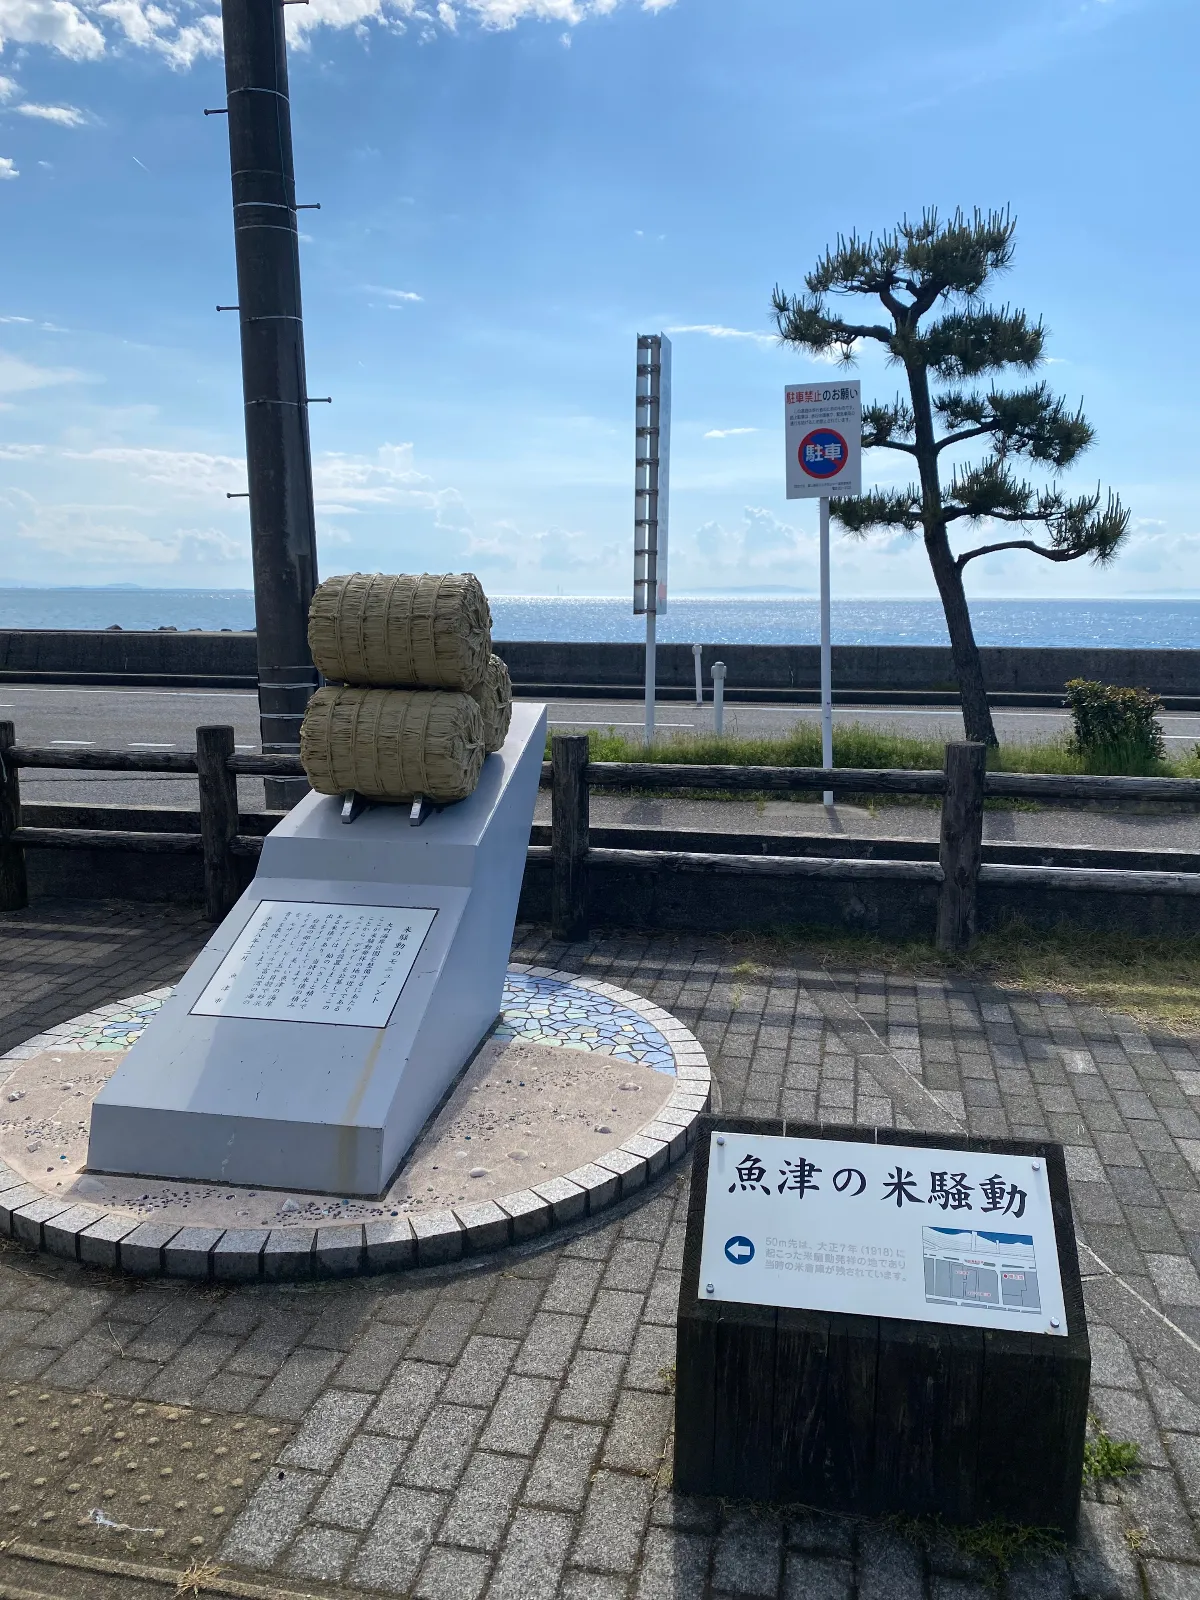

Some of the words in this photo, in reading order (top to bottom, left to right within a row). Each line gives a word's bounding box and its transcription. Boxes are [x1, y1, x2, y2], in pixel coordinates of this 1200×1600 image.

[786, 387, 858, 404] 駐車禁止のお願い
[806, 443, 841, 462] 駐車
[372, 926, 412, 1003] 米騒動のモニュメント
[728, 1154, 1028, 1219] 魚津の米騒動
[765, 1248, 906, 1270] 起こった米騒動発祥の地であり
[765, 1259, 907, 1282] 当時の米倉庫が残されています。
